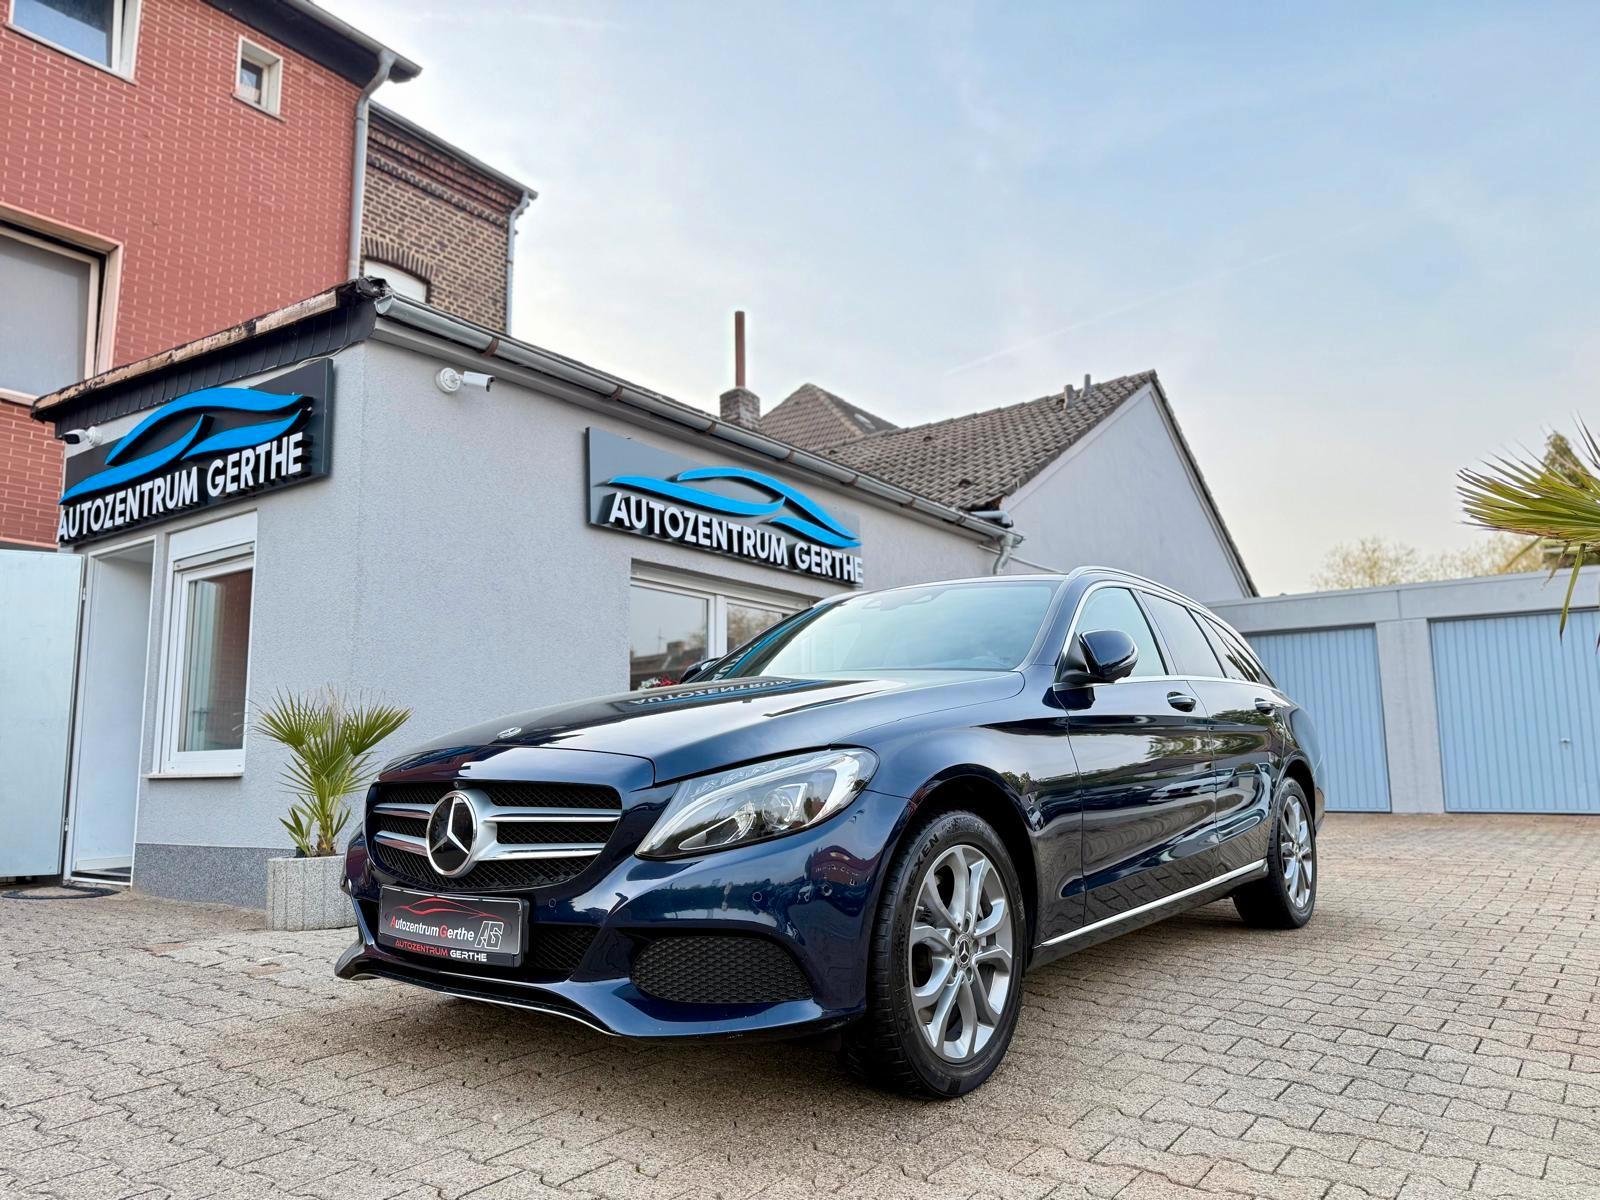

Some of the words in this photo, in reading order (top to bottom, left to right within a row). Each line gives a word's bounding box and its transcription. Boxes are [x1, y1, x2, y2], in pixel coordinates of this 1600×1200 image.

[56, 466, 199, 543] AUTOZENTRUM
[206, 432, 304, 497] GERTHE
[609, 491, 789, 566] AUTOZENTRUM
[794, 541, 865, 584] GERTHE
[395, 939, 448, 956] AUTOZENTRUM
[450, 950, 488, 962] GERTHE
